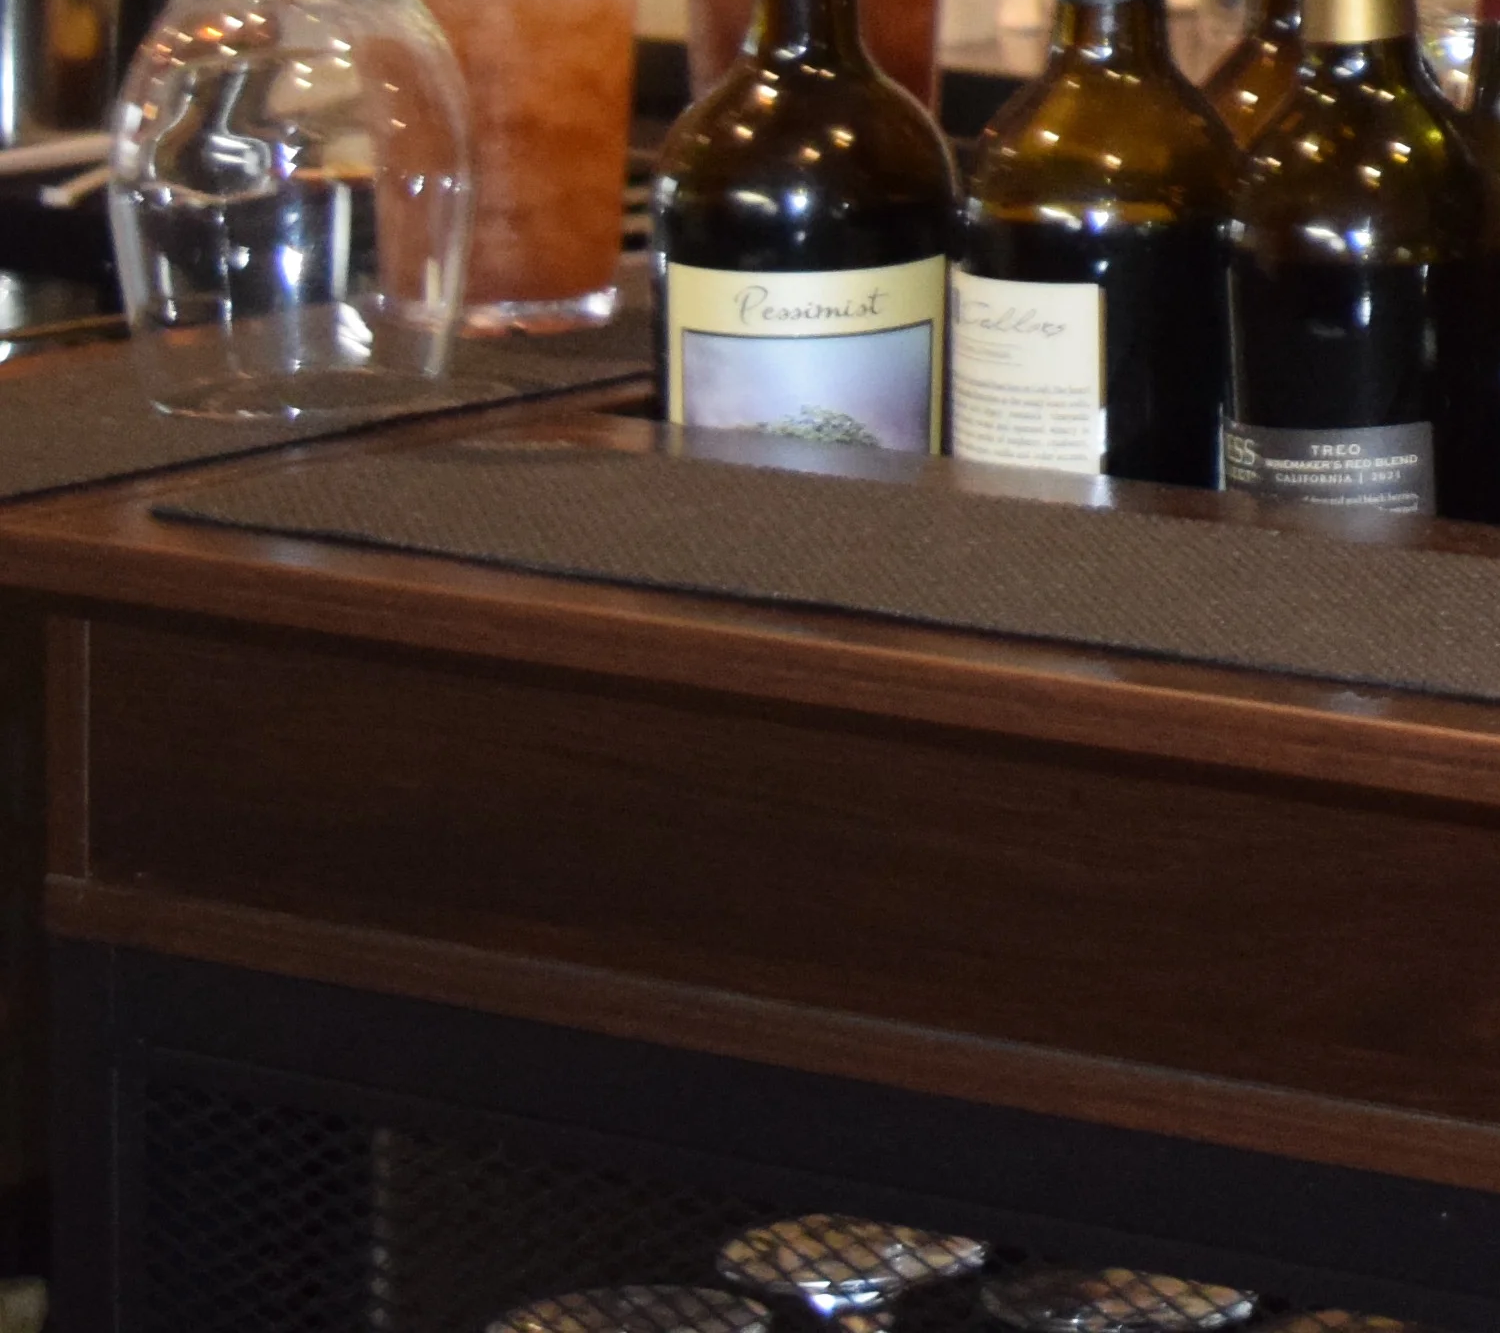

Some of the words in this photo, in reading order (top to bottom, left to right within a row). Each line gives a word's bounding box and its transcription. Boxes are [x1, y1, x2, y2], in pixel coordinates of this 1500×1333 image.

[734, 285, 889, 325] Pessimist
[1311, 443, 1362, 456] TREO
[1375, 454, 1419, 468] BLEND
[1275, 472, 1353, 485] CALIFORNIA
